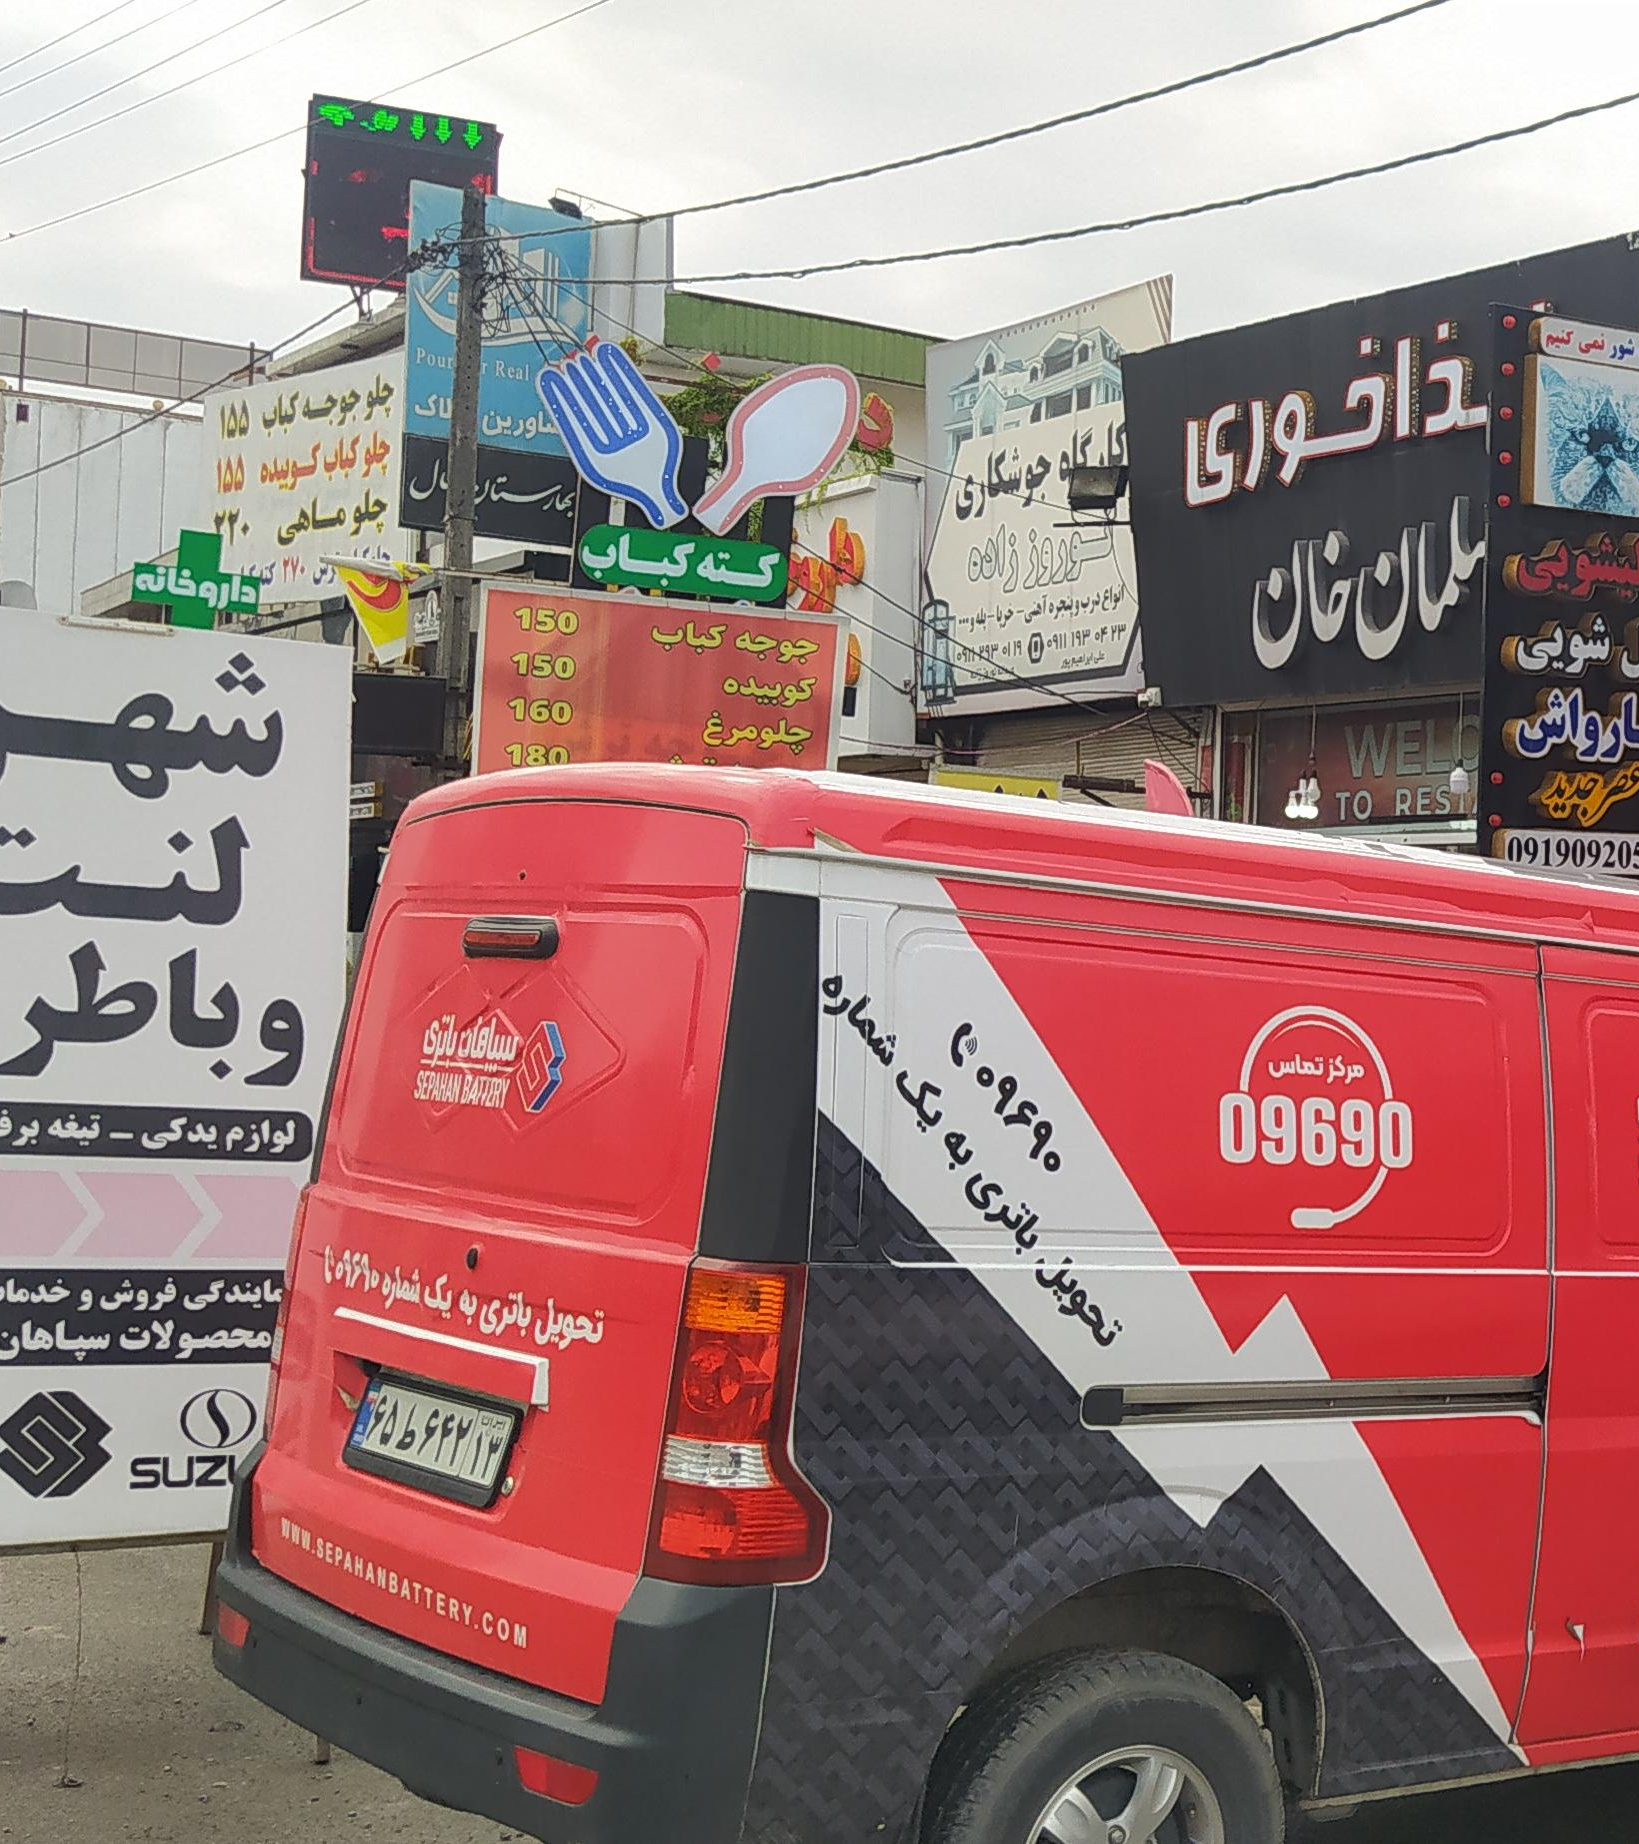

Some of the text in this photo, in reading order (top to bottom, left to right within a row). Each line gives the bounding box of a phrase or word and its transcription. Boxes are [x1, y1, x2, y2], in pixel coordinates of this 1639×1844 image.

[1545, 331, 1574, 348] کنیم
[1578, 333, 1606, 354] نمی
[1609, 338, 1635, 360] شور
[495, 363, 531, 382] Real
[219, 373, 395, 440] چلو جوجه کباب ۱۵۵
[1184, 319, 1490, 508] ذاخوری
[216, 453, 245, 494] ۱۵۵
[259, 441, 321, 490] کوبیده
[323, 435, 361, 481] کباب
[361, 431, 391, 478] چلو
[956, 446, 1052, 521] جوشکاری
[277, 497, 347, 546] ماهی
[350, 488, 388, 537] چلو
[581, 534, 696, 587] کباب
[697, 551, 780, 589] کته
[134, 565, 258, 610] داروخانه
[1252, 530, 1361, 670] خان
[513, 607, 819, 665] جوجه کباب 150
[1517, 617, 1611, 674] شویی
[511, 652, 817, 707] کوبیده 150
[508, 697, 573, 725] 160
[504, 743, 570, 766] 180
[1335, 789, 1373, 821] TO
[458, 1016, 520, 1073] سپاهان
[413, 1074, 511, 1109] SEPAHAN BATTERY
[1267, 1053, 1366, 1085] مرکز تماس
[47, 1113, 102, 1153] تیغه
[141, 1116, 218, 1151] یدکی
[226, 1119, 297, 1155] لوازم
[976, 1065, 1062, 1174] ۰۹۶۹۰
[1219, 1092, 1414, 1170] 09690
[822, 974, 1124, 1348] تحویل باتری به یک شماره
[0, 1277, 283, 1317] مایندگی فروش و خدما
[335, 1249, 605, 1350] تحویل باتری به یک شماره ۰۹۶۹۰
[119, 1320, 272, 1360] محصولات
[364, 1389, 397, 1445] ۶۵
[396, 1401, 417, 1451] ط
[418, 1416, 474, 1467] ۶۴۲
[470, 1431, 502, 1480] ۱۳
[129, 1455, 238, 1490] SUZ
[280, 1516, 529, 1651] WWW.SEPAHANBATTERY.COM
